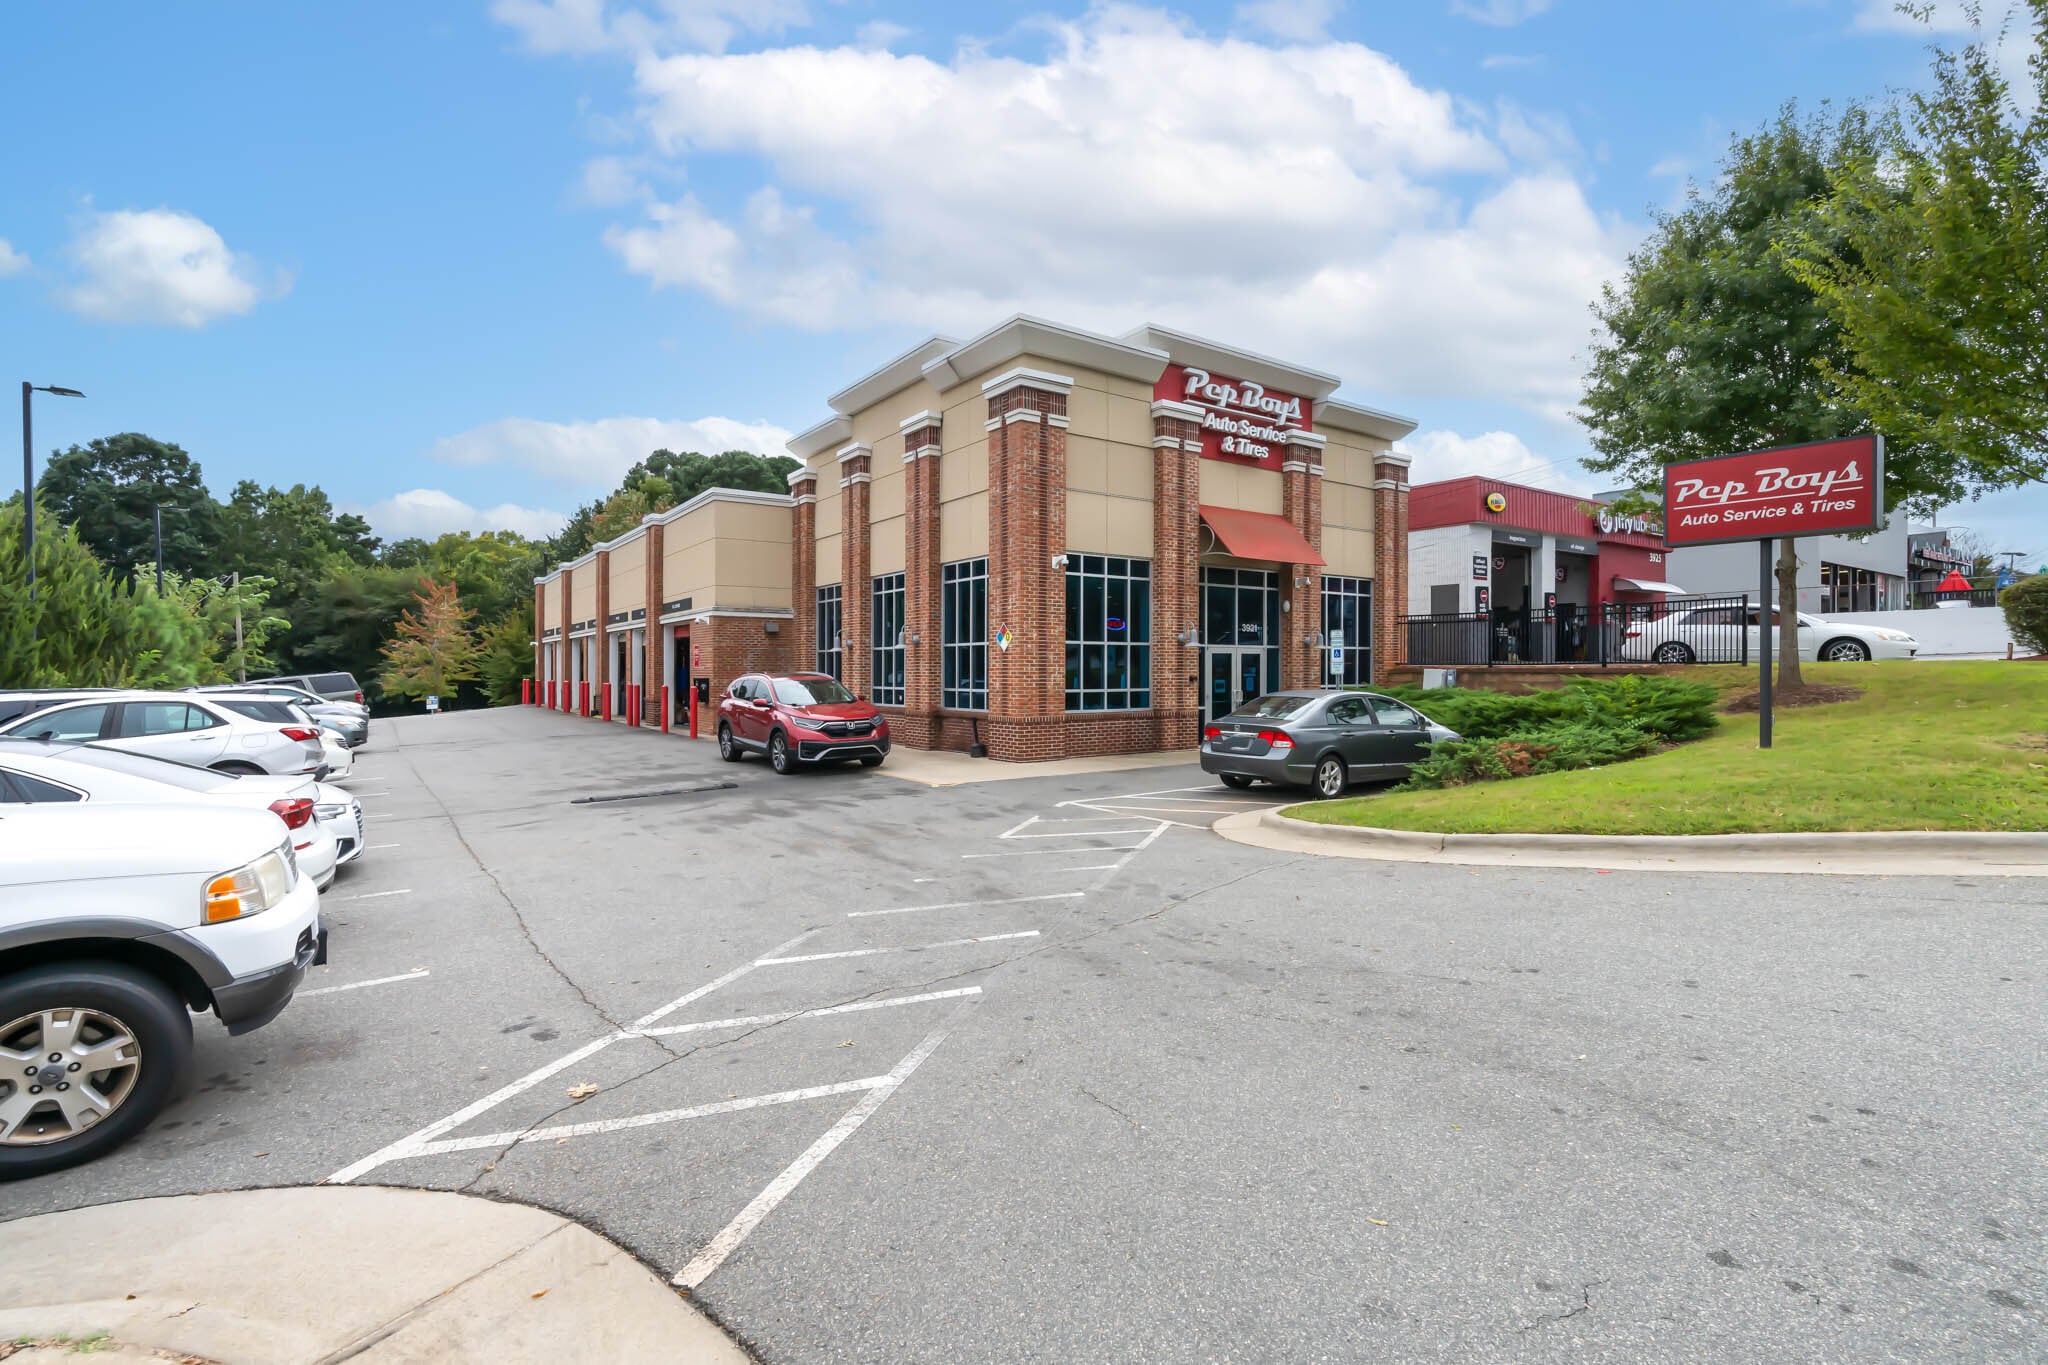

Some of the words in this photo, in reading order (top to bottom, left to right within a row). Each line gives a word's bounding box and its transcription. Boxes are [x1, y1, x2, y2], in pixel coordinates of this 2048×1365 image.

[1183, 367, 1239, 407] Pep
[1240, 381, 1302, 426] Boys
[1204, 412, 1237, 433] Auto
[1238, 420, 1287, 443] Service
[1222, 436, 1235, 452] &
[1236, 438, 1269, 458] Tires
[1673, 478, 1748, 503] Pep
[1754, 460, 1863, 496] Boys
[1680, 514, 1719, 527] Auto
[1722, 505, 1787, 522] Service
[1791, 503, 1804, 515] &
[1810, 499, 1856, 513] Tires
[1649, 552, 1662, 563] 3925
